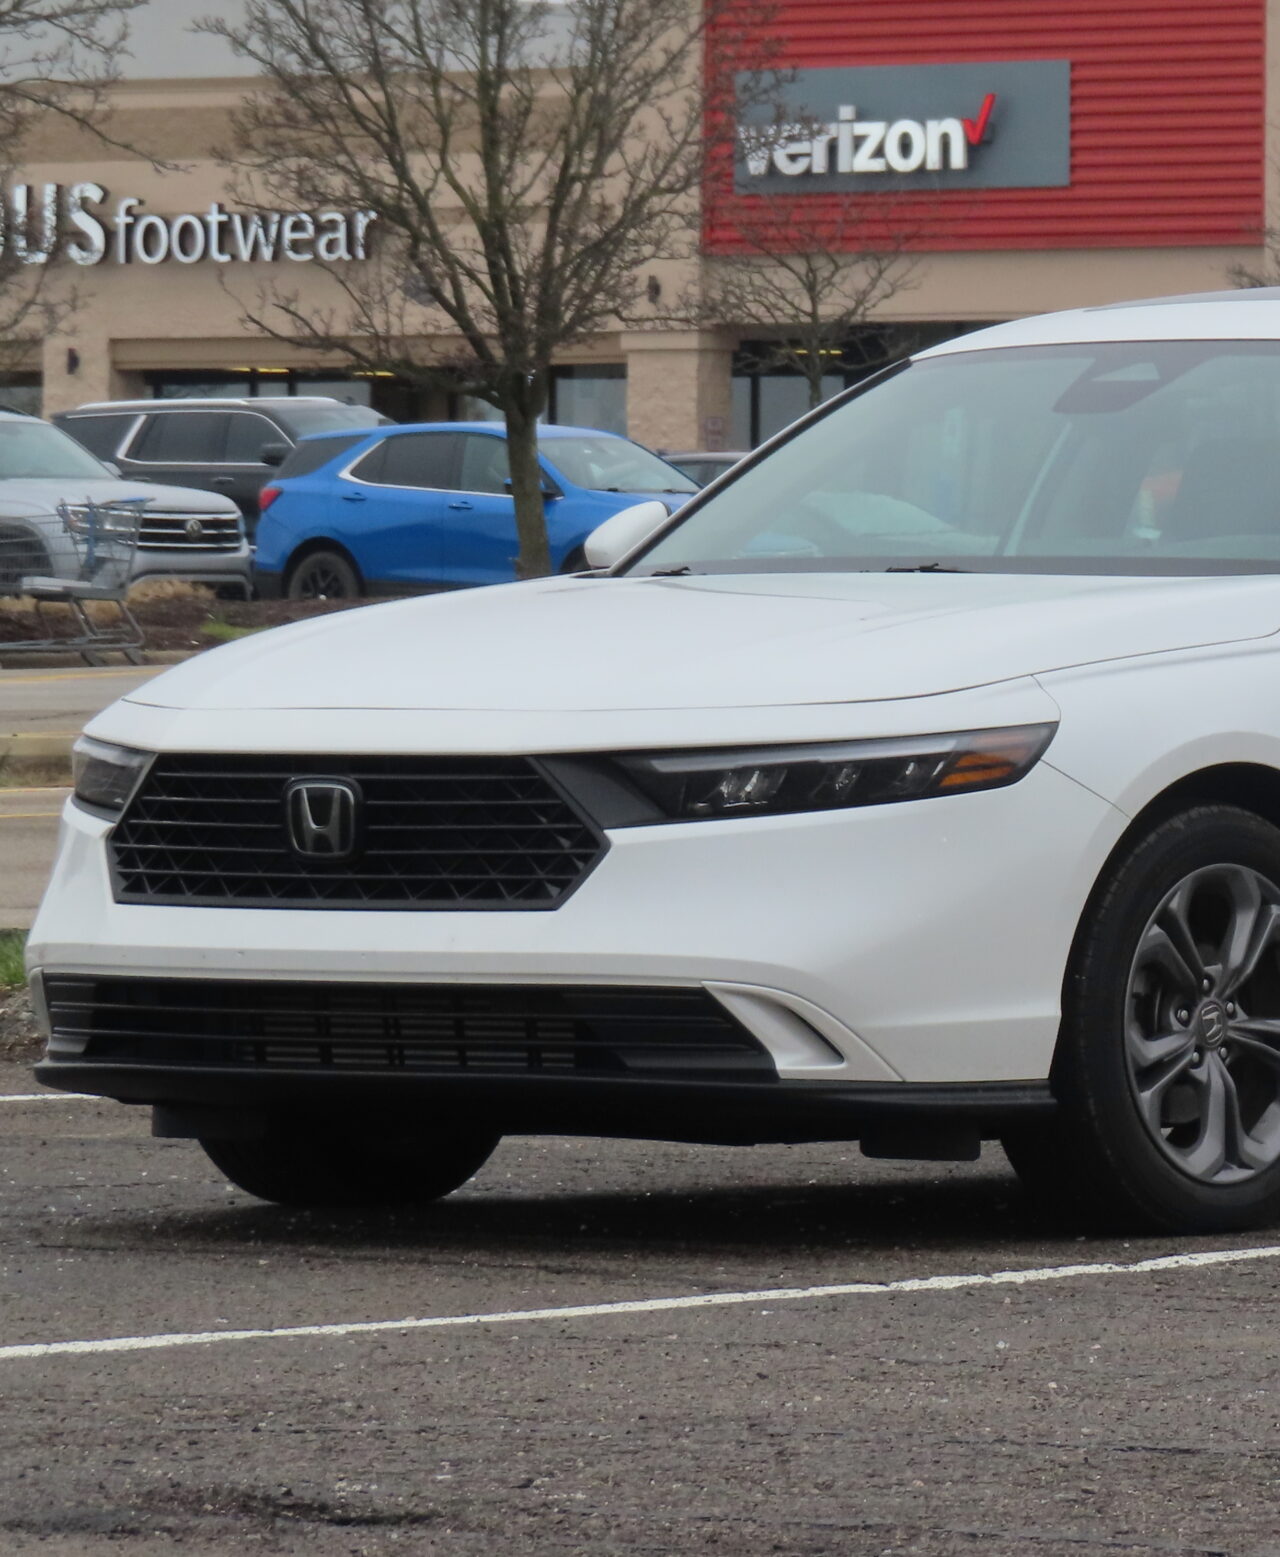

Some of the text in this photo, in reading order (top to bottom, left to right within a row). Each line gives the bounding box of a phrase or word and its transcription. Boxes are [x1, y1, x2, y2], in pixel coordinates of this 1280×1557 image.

[738, 105, 968, 176] verizon
[0, 183, 378, 265] US footwear
